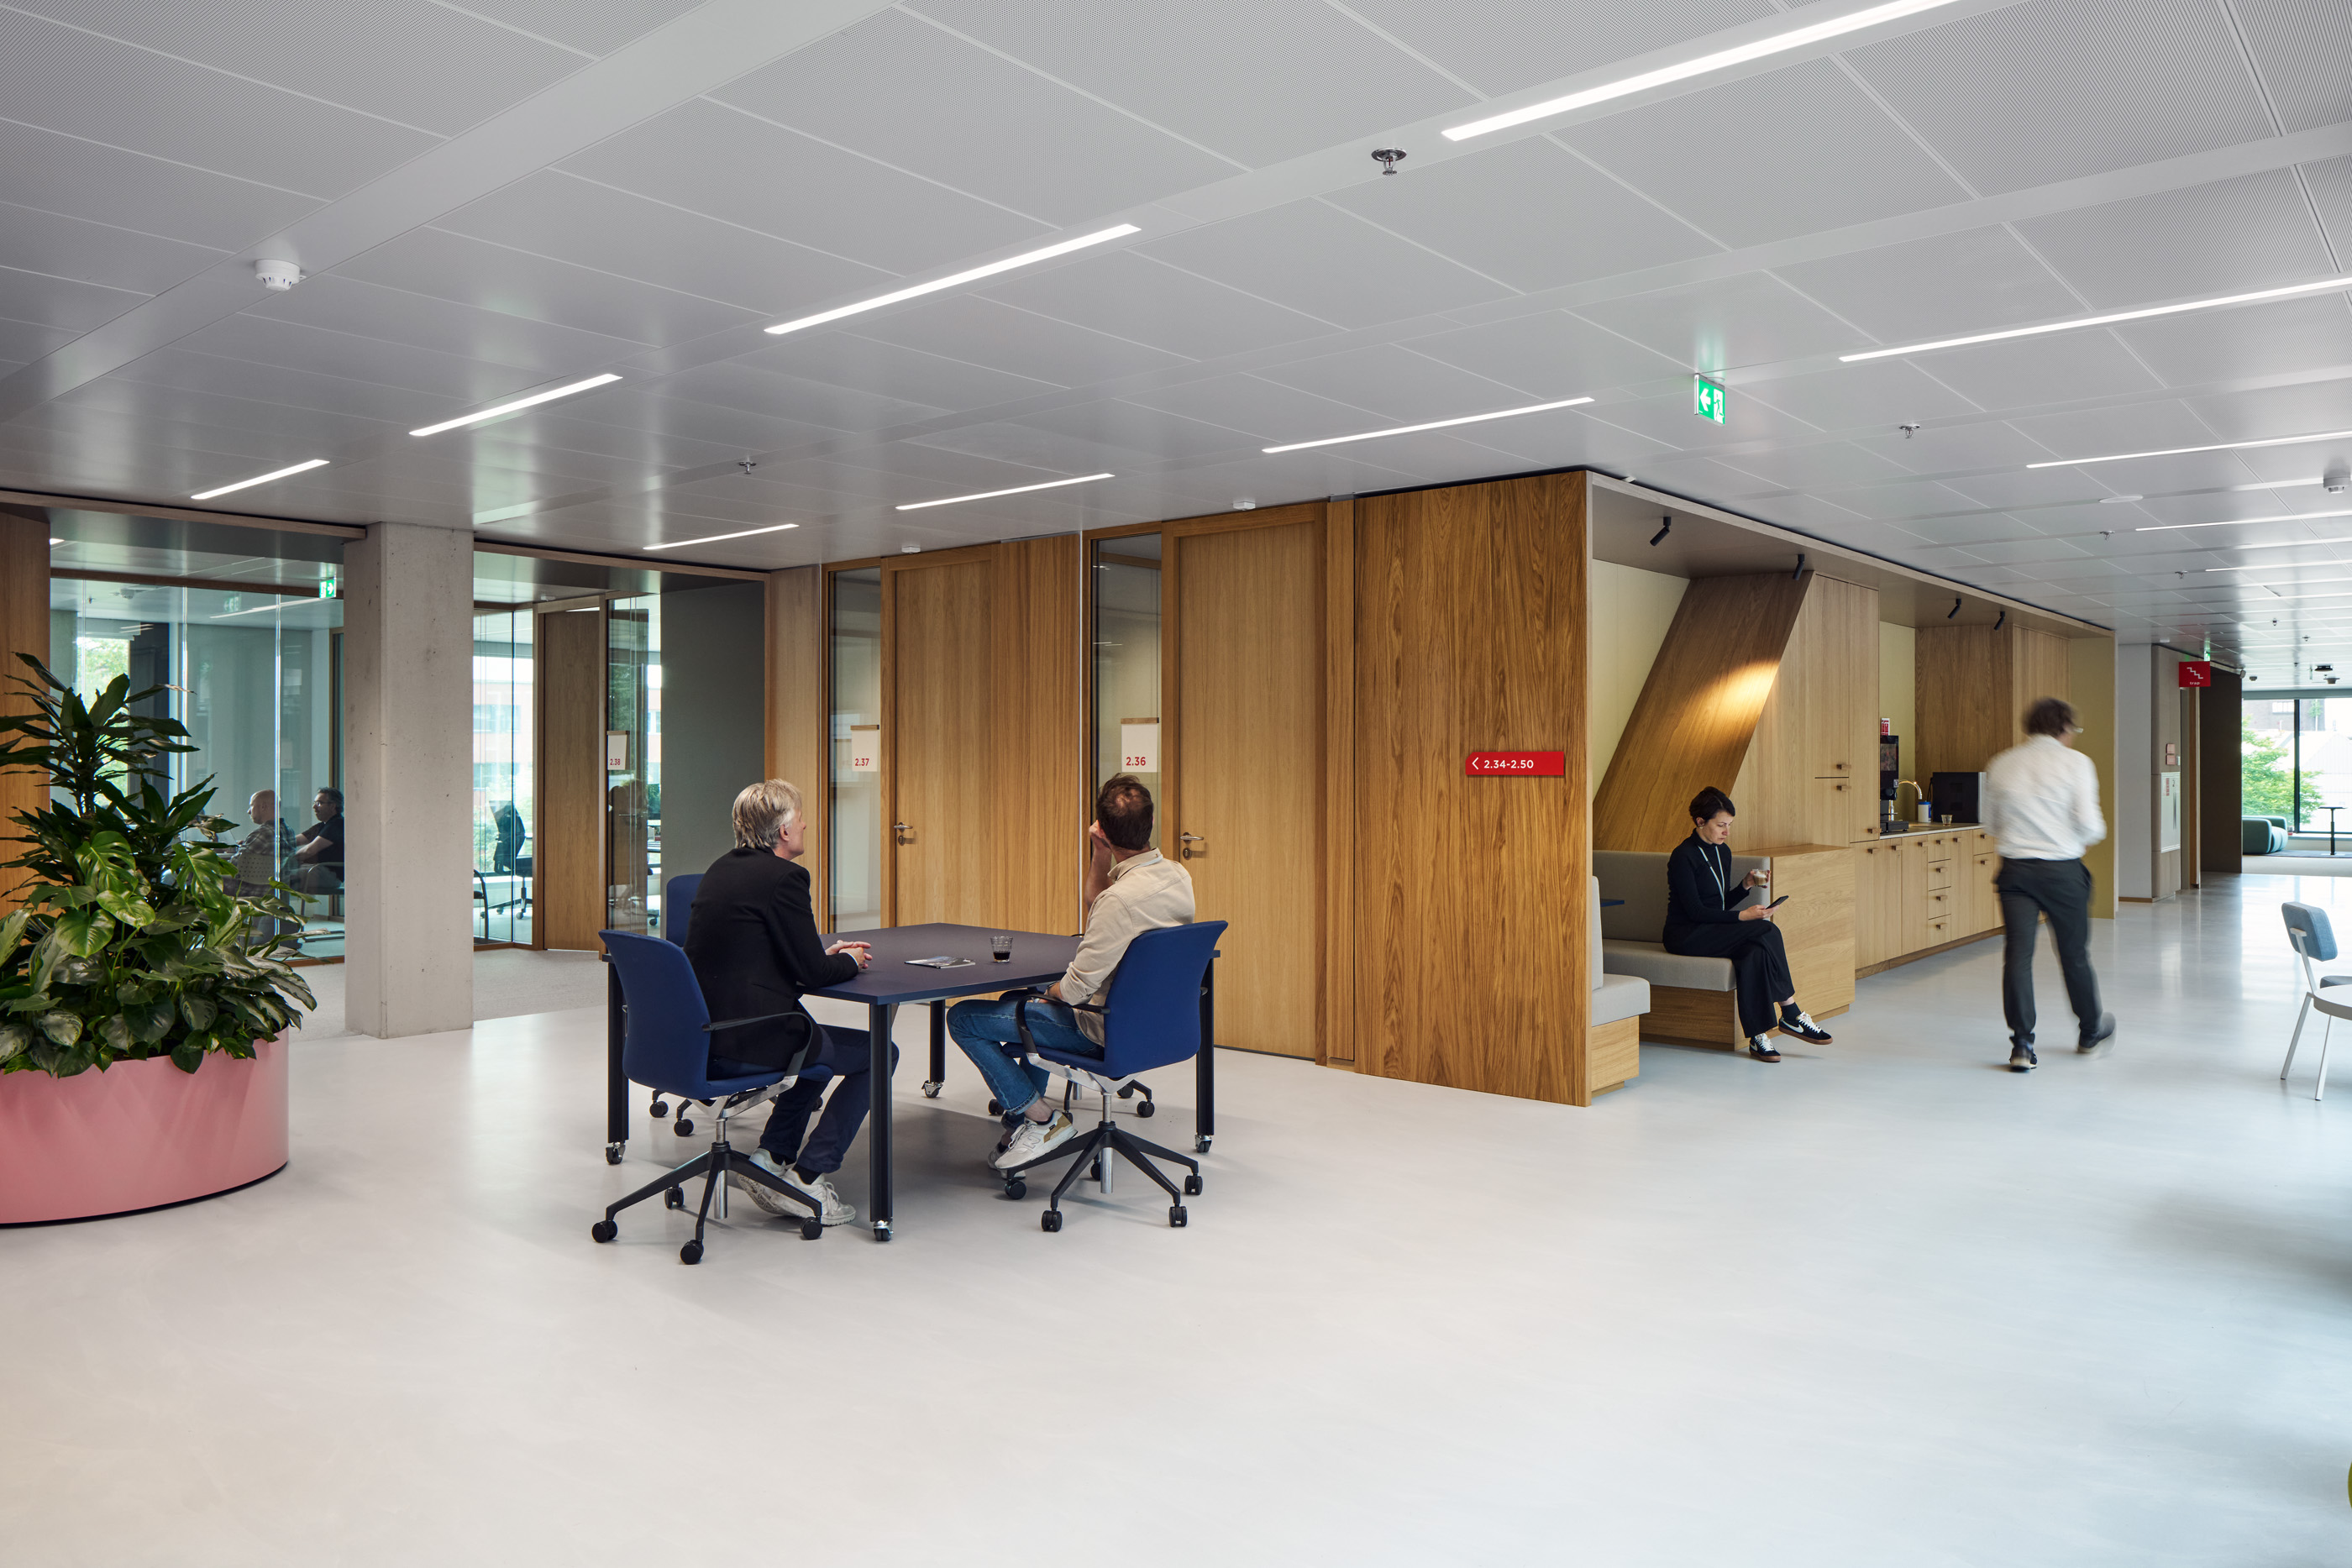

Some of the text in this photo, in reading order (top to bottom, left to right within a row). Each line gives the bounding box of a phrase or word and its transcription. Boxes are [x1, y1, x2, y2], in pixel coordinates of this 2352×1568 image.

[854, 758, 869, 766] 2.37
[1126, 756, 1146, 766] 2.36
[1483, 759, 1534, 768] 2.34-2.50
